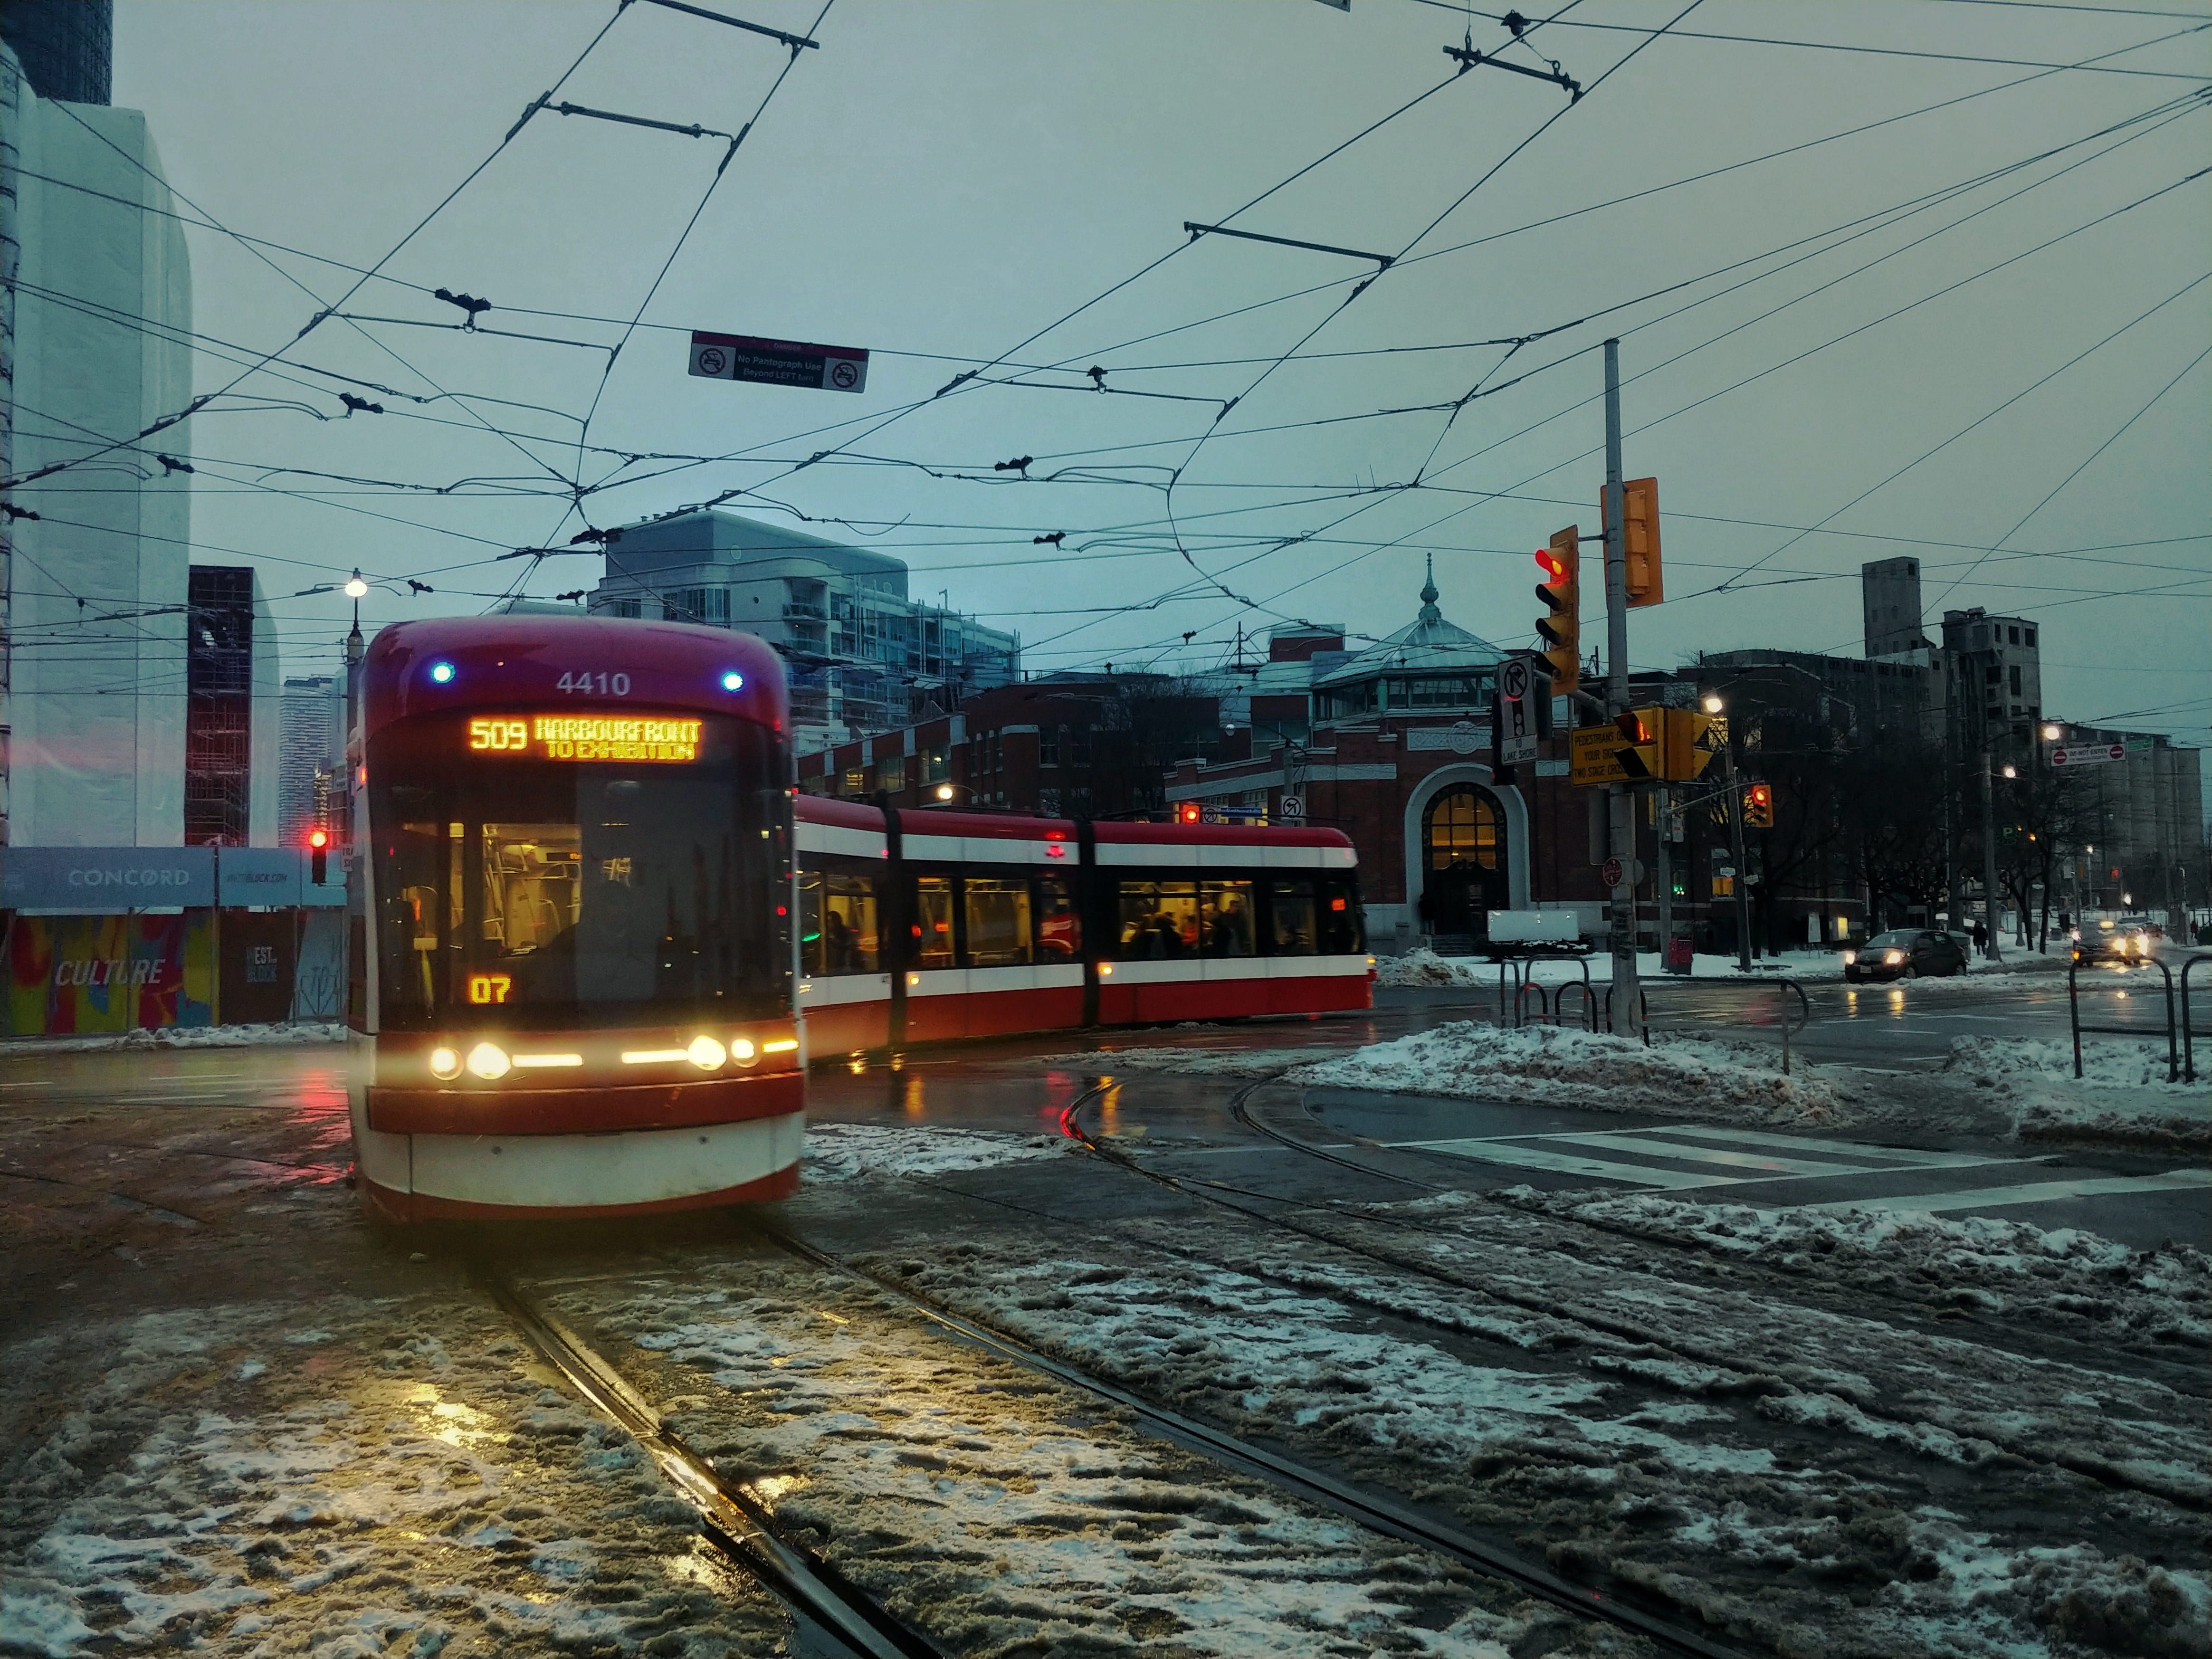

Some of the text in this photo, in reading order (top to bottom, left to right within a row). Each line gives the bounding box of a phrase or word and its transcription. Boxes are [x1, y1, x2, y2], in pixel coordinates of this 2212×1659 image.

[738, 354, 822, 371] No Pantograph Use
[744, 368, 774, 378] Beyond
[799, 374, 814, 382] turn
[556, 671, 630, 696] 4410
[471, 718, 702, 750] 509 HARBOURFRONT
[1574, 732, 1614, 746] PEDESTRIANS
[546, 741, 574, 757] TO
[1516, 739, 1522, 748] TO
[1503, 748, 1536, 762] LAKE SHORE
[1585, 750, 1600, 760] YOUR
[1574, 767, 1586, 779] TWO
[1588, 765, 1605, 778] STAGE
[2002, 828, 2012, 837] P
[55, 958, 166, 986] CULTURE
[471, 978, 511, 1003] 07
